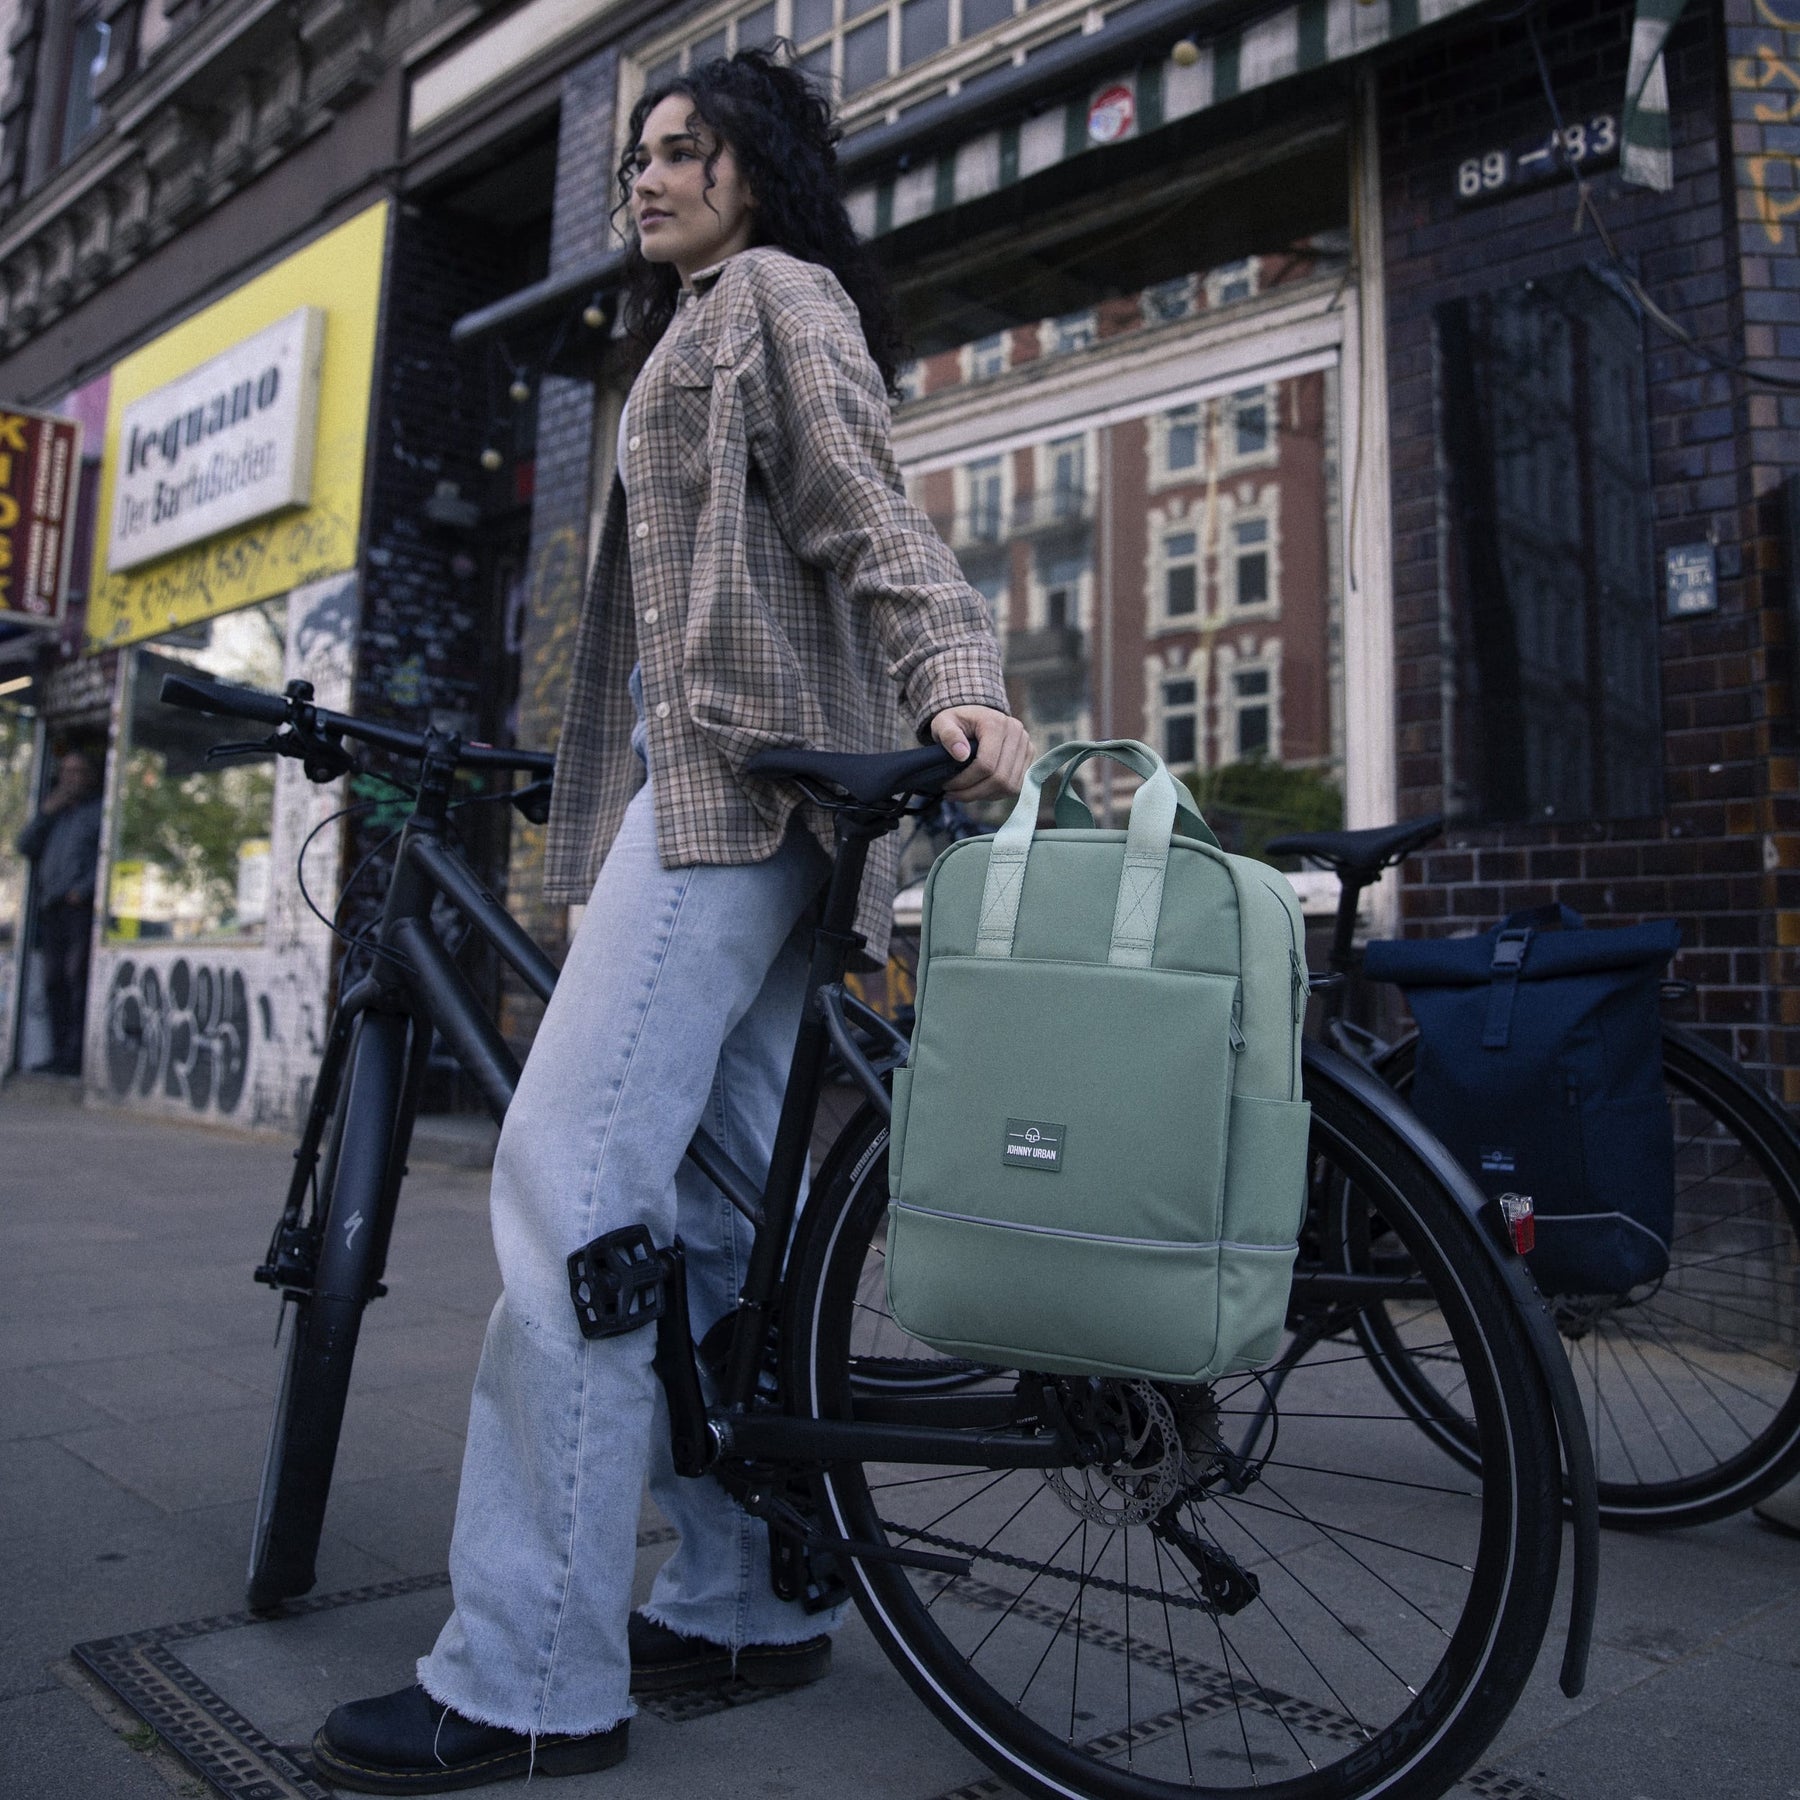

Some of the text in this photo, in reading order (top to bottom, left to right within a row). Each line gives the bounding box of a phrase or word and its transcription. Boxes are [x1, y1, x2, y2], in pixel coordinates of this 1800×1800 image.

[1458, 152, 1506, 196] 69
[1006, 1144, 1057, 1160] JOHNNY URBAN
